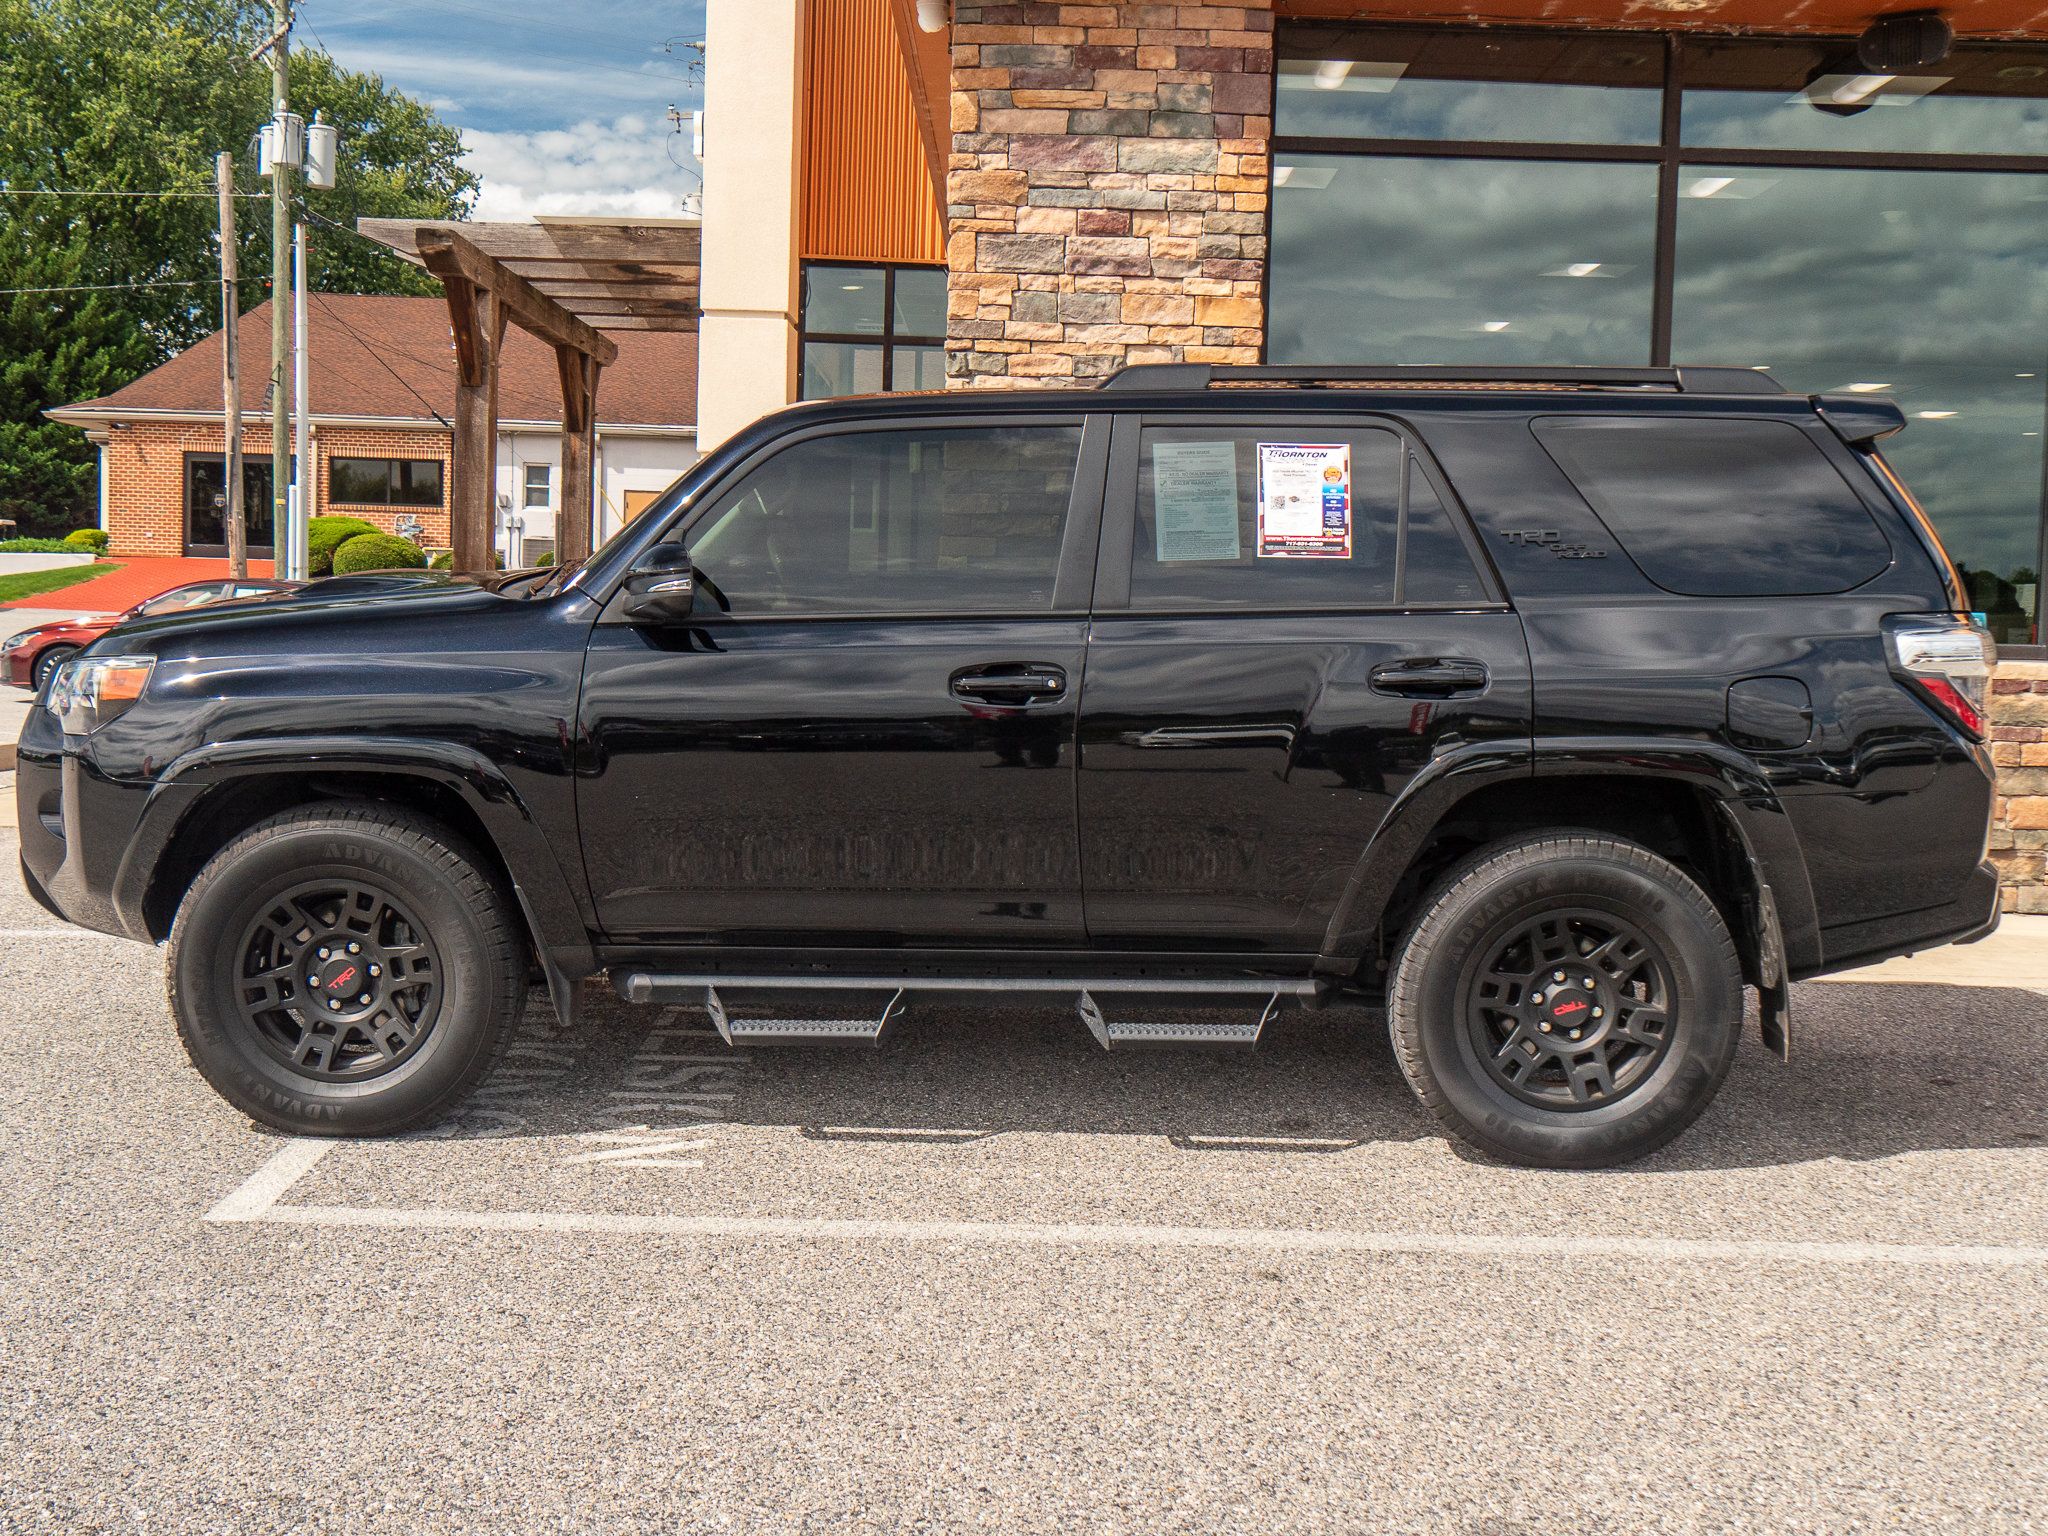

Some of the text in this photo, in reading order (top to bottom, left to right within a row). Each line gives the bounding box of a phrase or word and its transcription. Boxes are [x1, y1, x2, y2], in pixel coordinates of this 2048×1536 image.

[1268, 450, 1328, 458] THORNTON
[1500, 529, 1561, 547] TRD
[1550, 543, 1587, 552] OFF
[1556, 551, 1608, 559] ROAD
[328, 966, 357, 990] TRD
[1553, 1001, 1587, 1016] TRD
